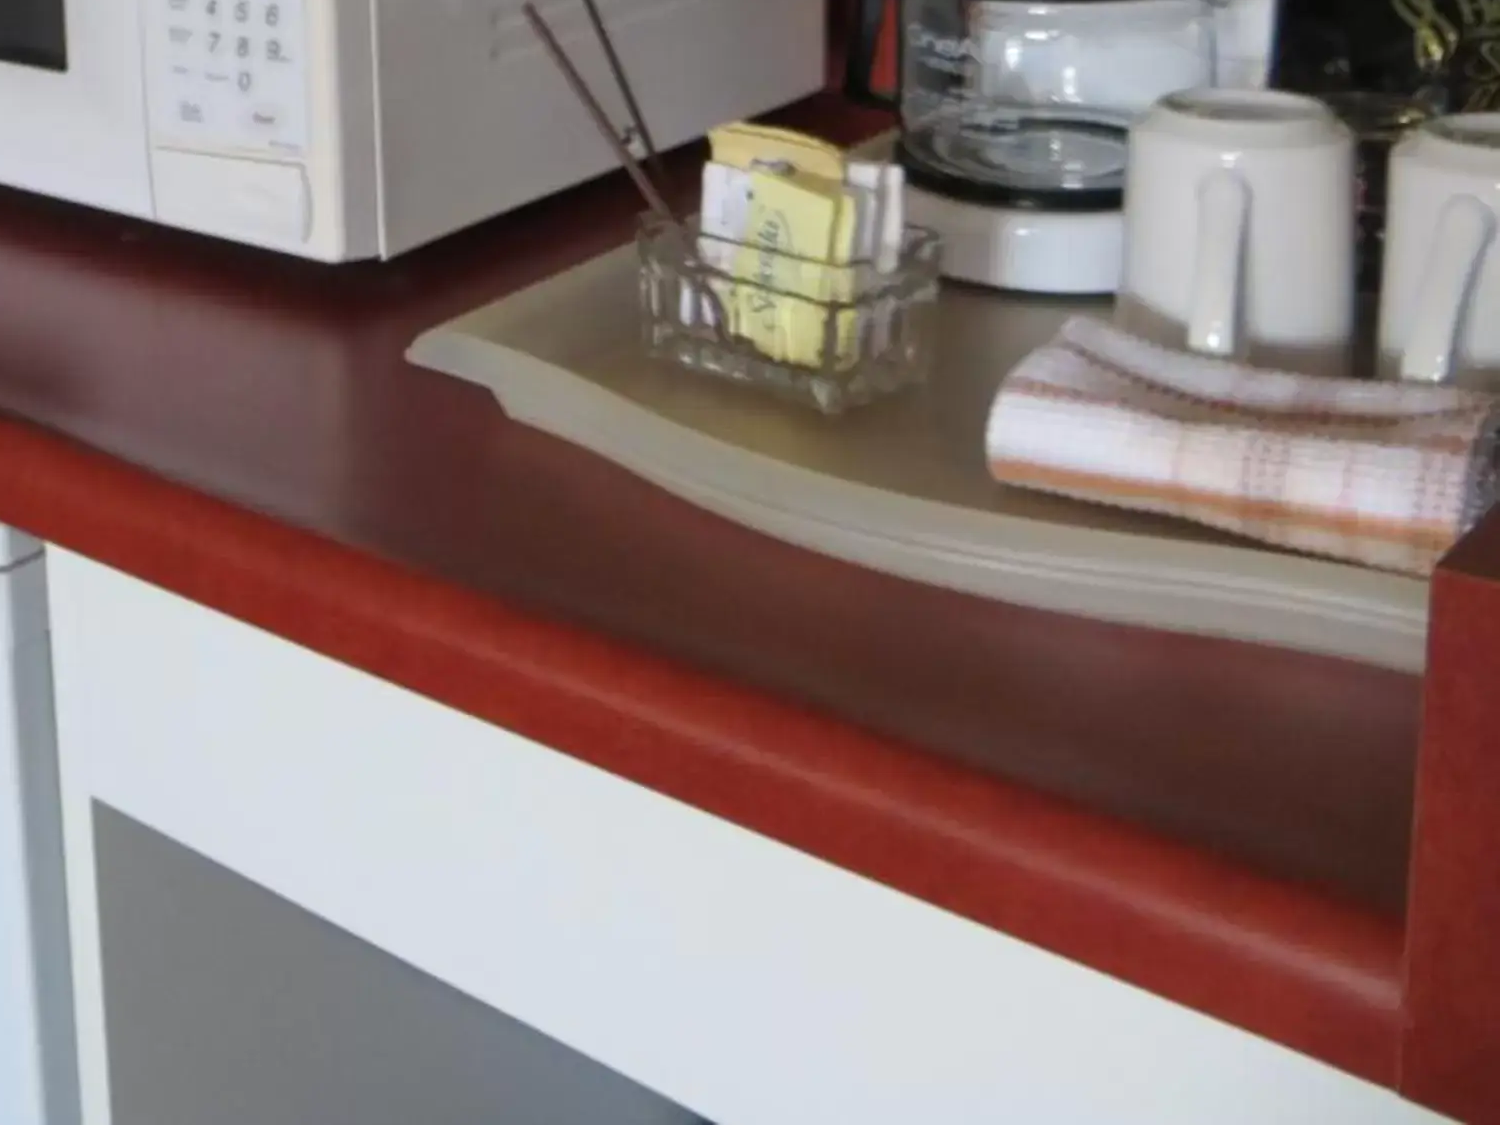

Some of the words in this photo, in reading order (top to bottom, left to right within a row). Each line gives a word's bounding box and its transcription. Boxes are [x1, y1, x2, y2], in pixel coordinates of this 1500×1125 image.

[265, 3, 280, 26] 6
[208, 31, 221, 53] 7
[236, 36, 250, 58] 8
[237, 71, 252, 92] 0
